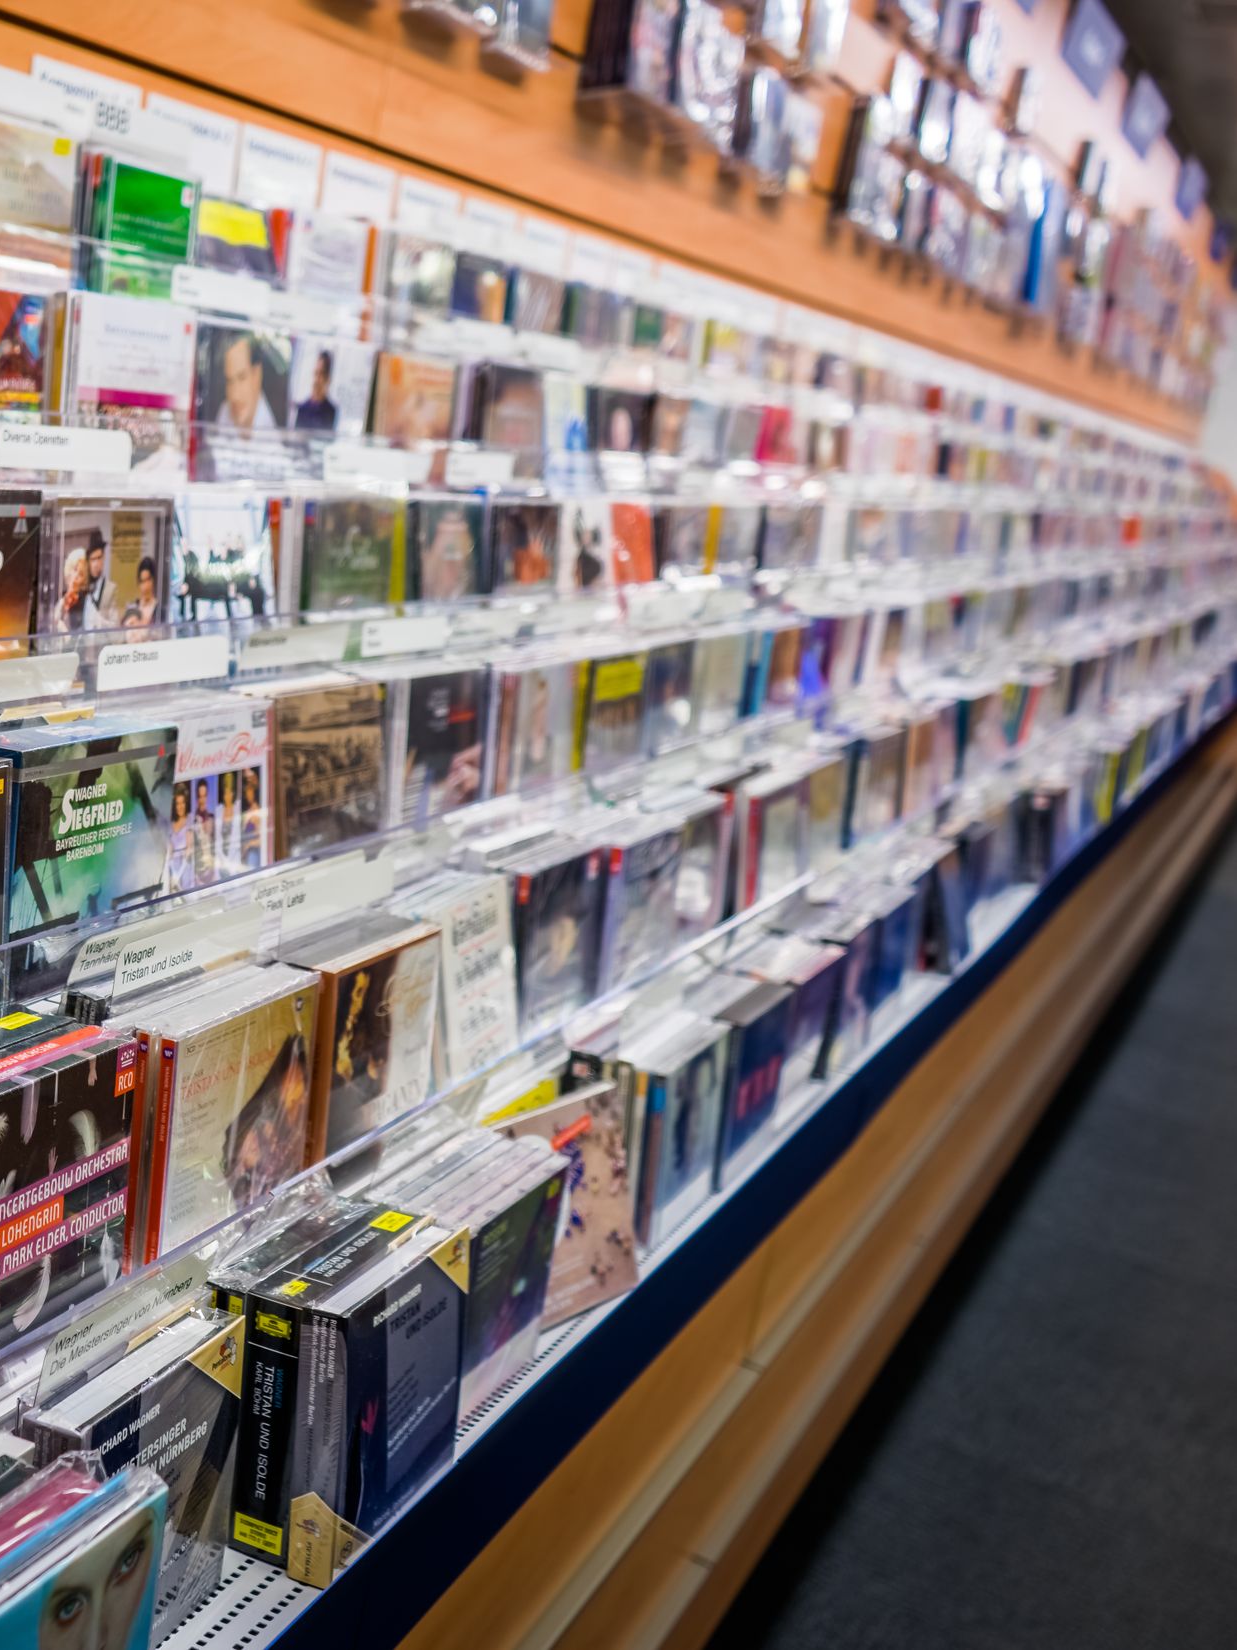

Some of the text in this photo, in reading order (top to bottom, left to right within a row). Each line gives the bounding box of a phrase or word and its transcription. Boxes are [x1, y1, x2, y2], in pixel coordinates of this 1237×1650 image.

[103, 649, 159, 666] Johann Strauss
[73, 783, 107, 802] WAGNER
[58, 788, 124, 834] SIEGFRIED
[55, 822, 132, 852] BAYREUTHER FESTSPIELE
[65, 842, 105, 862] BARENBOIM
[79, 950, 121, 974] Tannhäus
[85, 936, 120, 956] Wagner
[123, 944, 157, 967] Wagner
[121, 949, 194, 986] Tristan und Isolde
[118, 1071, 133, 1092] RCO
[74, 1143, 129, 1189] ORCHESTRA
[0, 1201, 61, 1249] LOHENGRIN
[2, 1245, 36, 1275] MARK
[35, 1226, 69, 1258] ELDER,
[48, 1276, 193, 1377] Die Meistersinger von Nürnberg
[53, 1322, 94, 1355] Wagner
[327, 1319, 338, 1379] RICHARD WAGNER
[252, 1361, 263, 1416] KARL BÖHM
[128, 1403, 161, 1434] WAGNER
[254, 1366, 275, 1500] TRISTAN UND ISOLDE
[157, 1420, 209, 1472] NÜRNBERG
